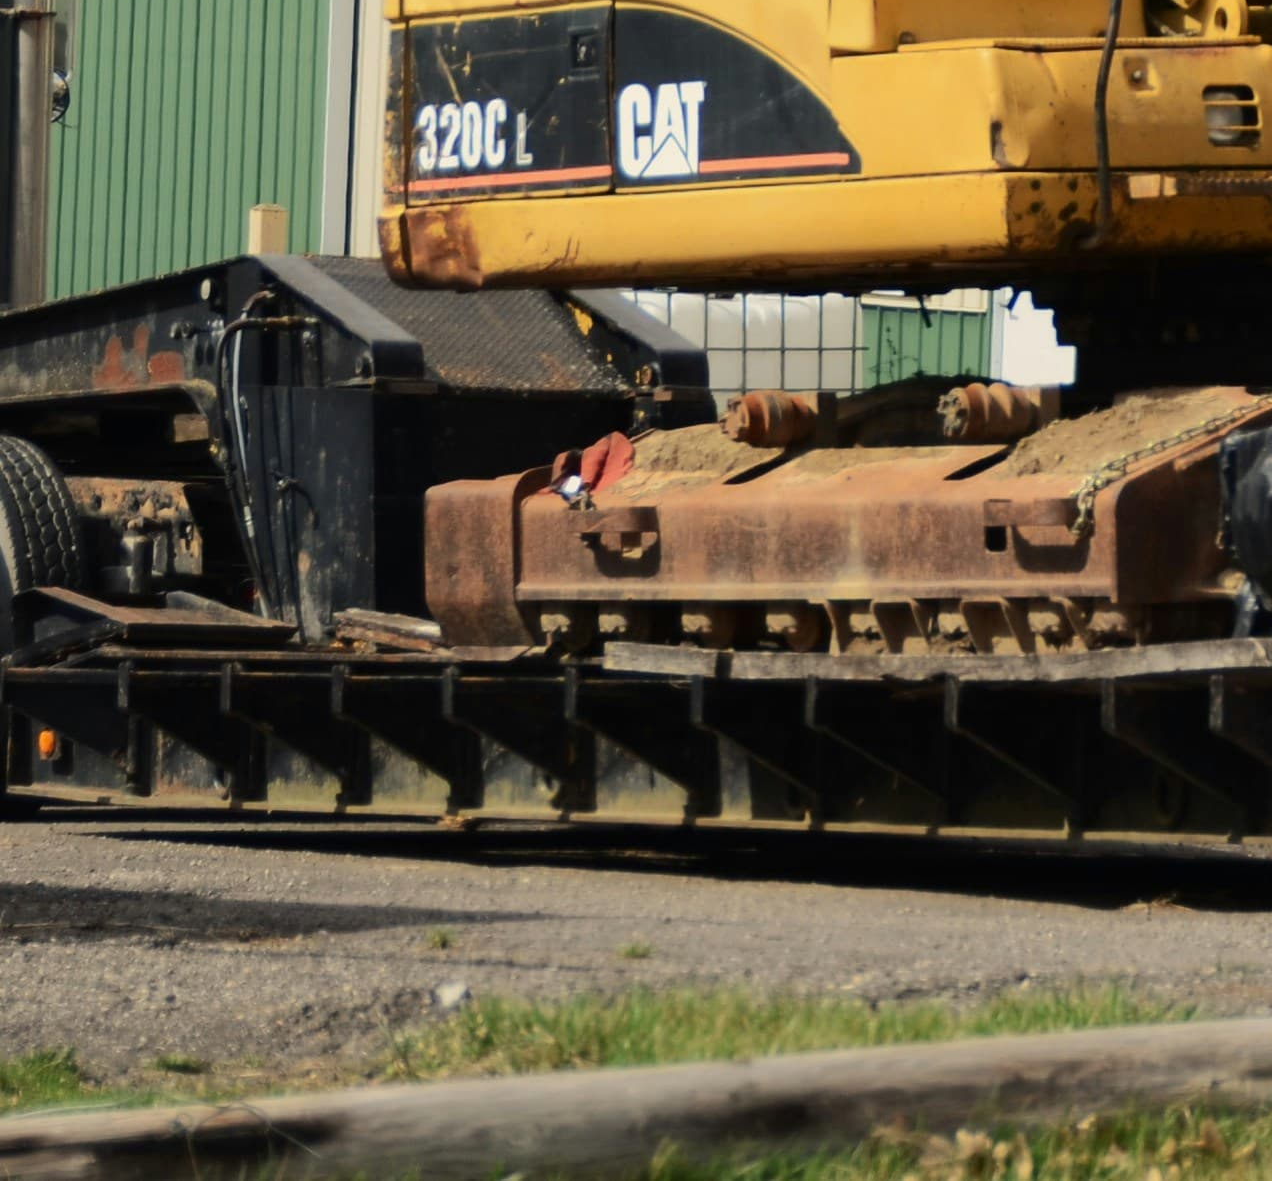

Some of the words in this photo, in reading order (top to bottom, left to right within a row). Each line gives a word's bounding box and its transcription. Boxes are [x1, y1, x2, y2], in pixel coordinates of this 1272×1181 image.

[418, 98, 507, 171] 320C
[515, 108, 533, 166] L
[618, 80, 706, 178] CAT
